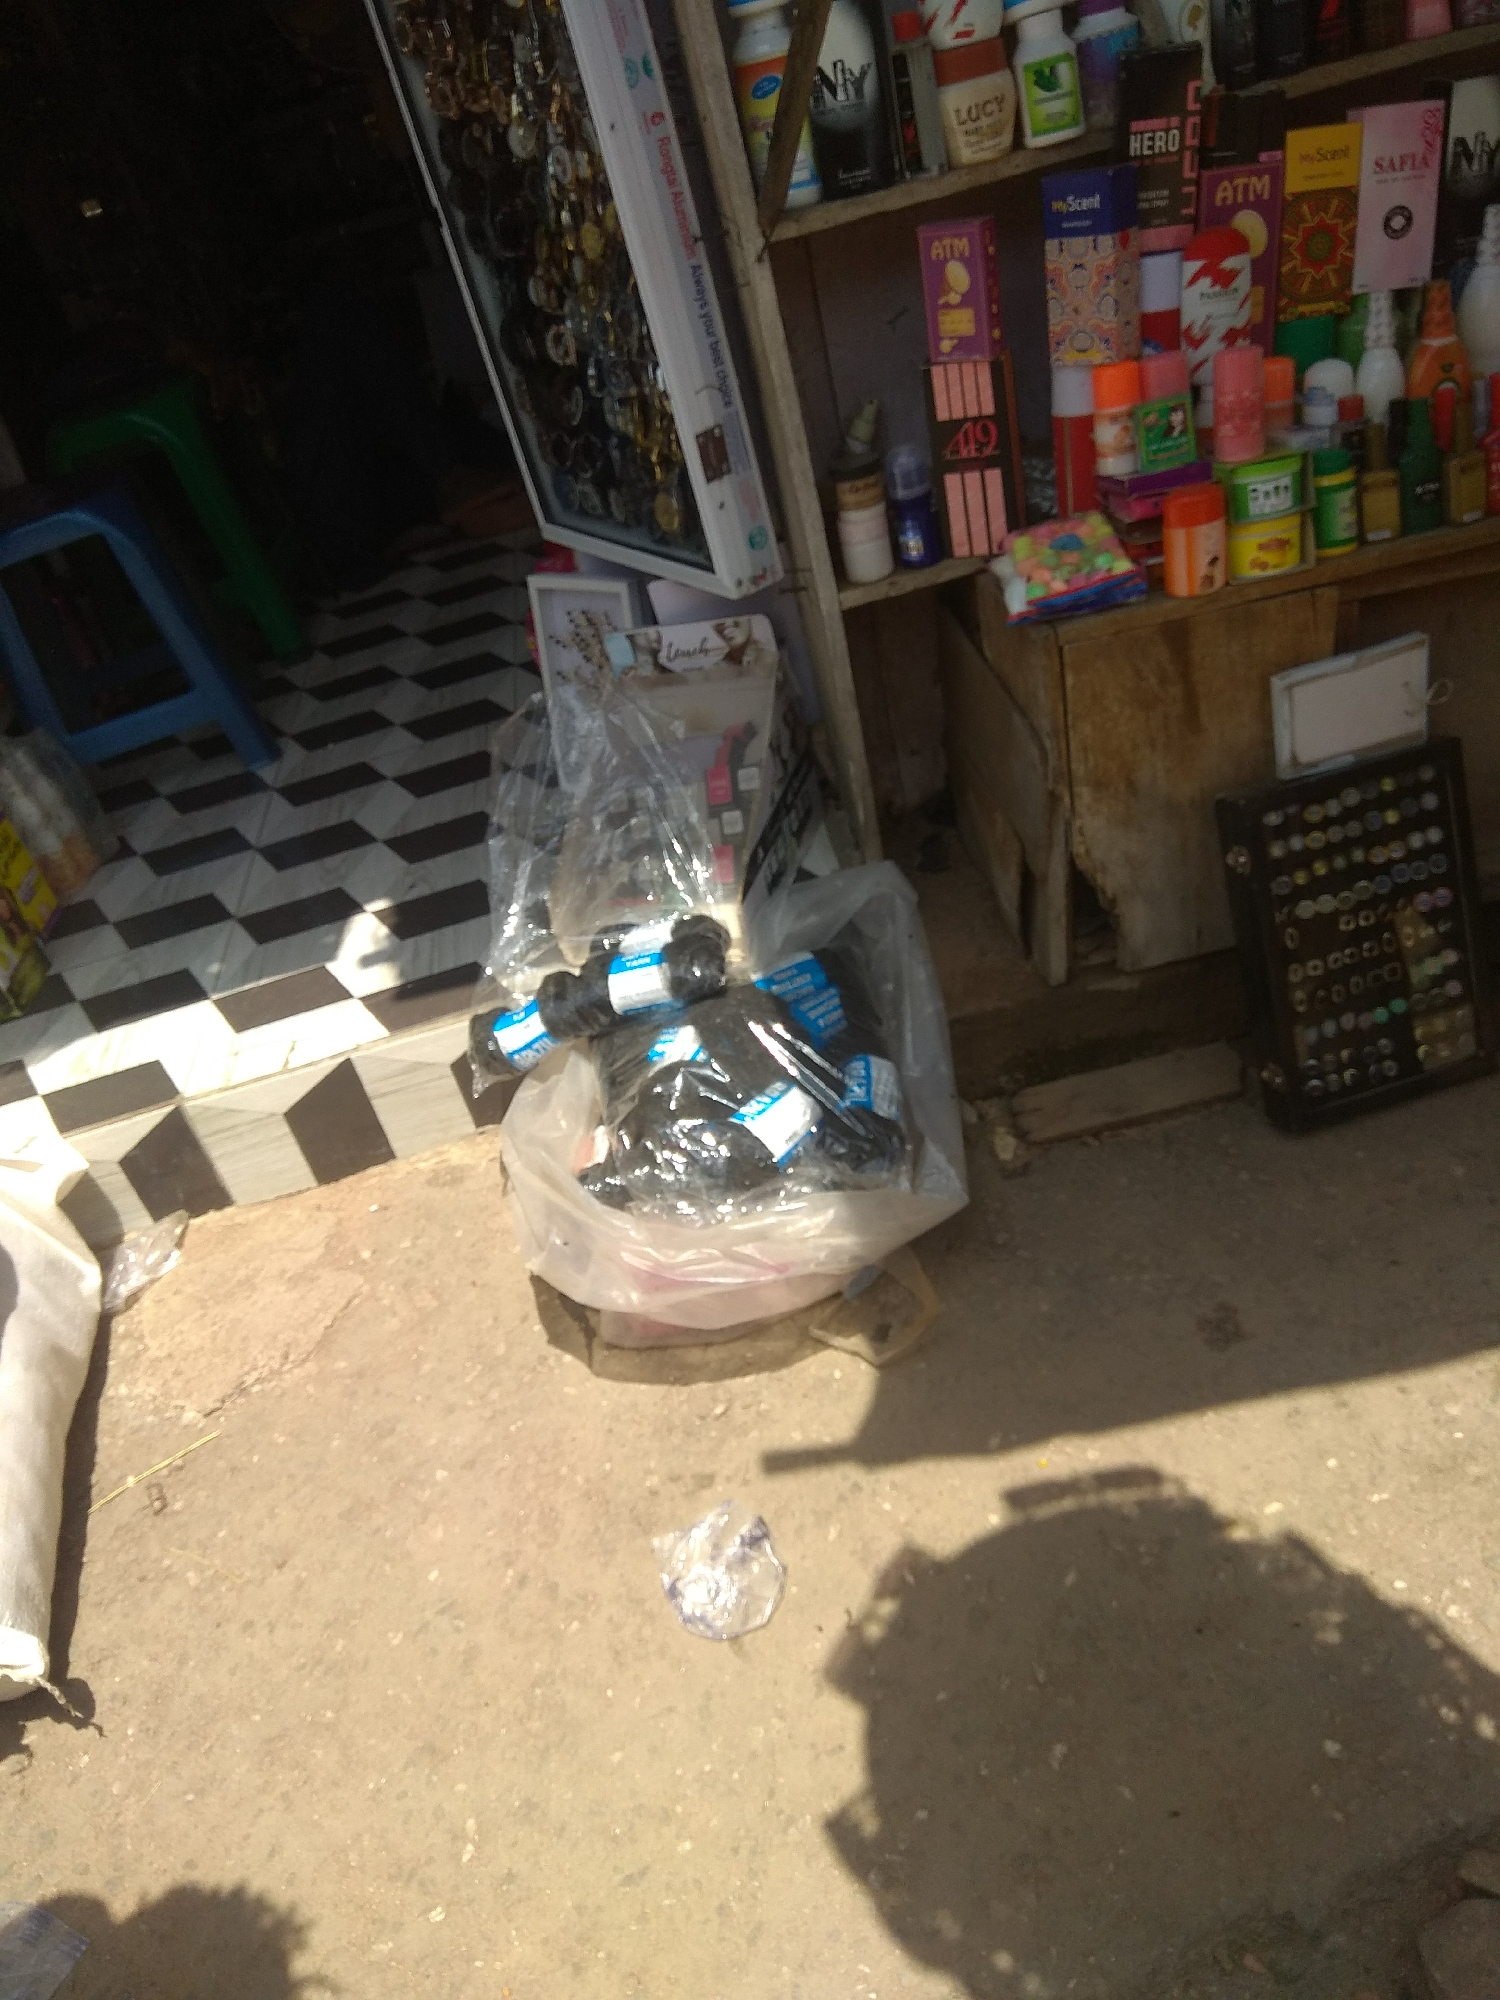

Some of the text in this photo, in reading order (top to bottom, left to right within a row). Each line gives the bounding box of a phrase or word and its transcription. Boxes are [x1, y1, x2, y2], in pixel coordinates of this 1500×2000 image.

[955, 95, 1006, 126] LUCY
[1129, 129, 1180, 158] HERO
[1214, 174, 1271, 207] ATM
[930, 237, 971, 262] ATM
[689, 263, 736, 408] Always your best choice
